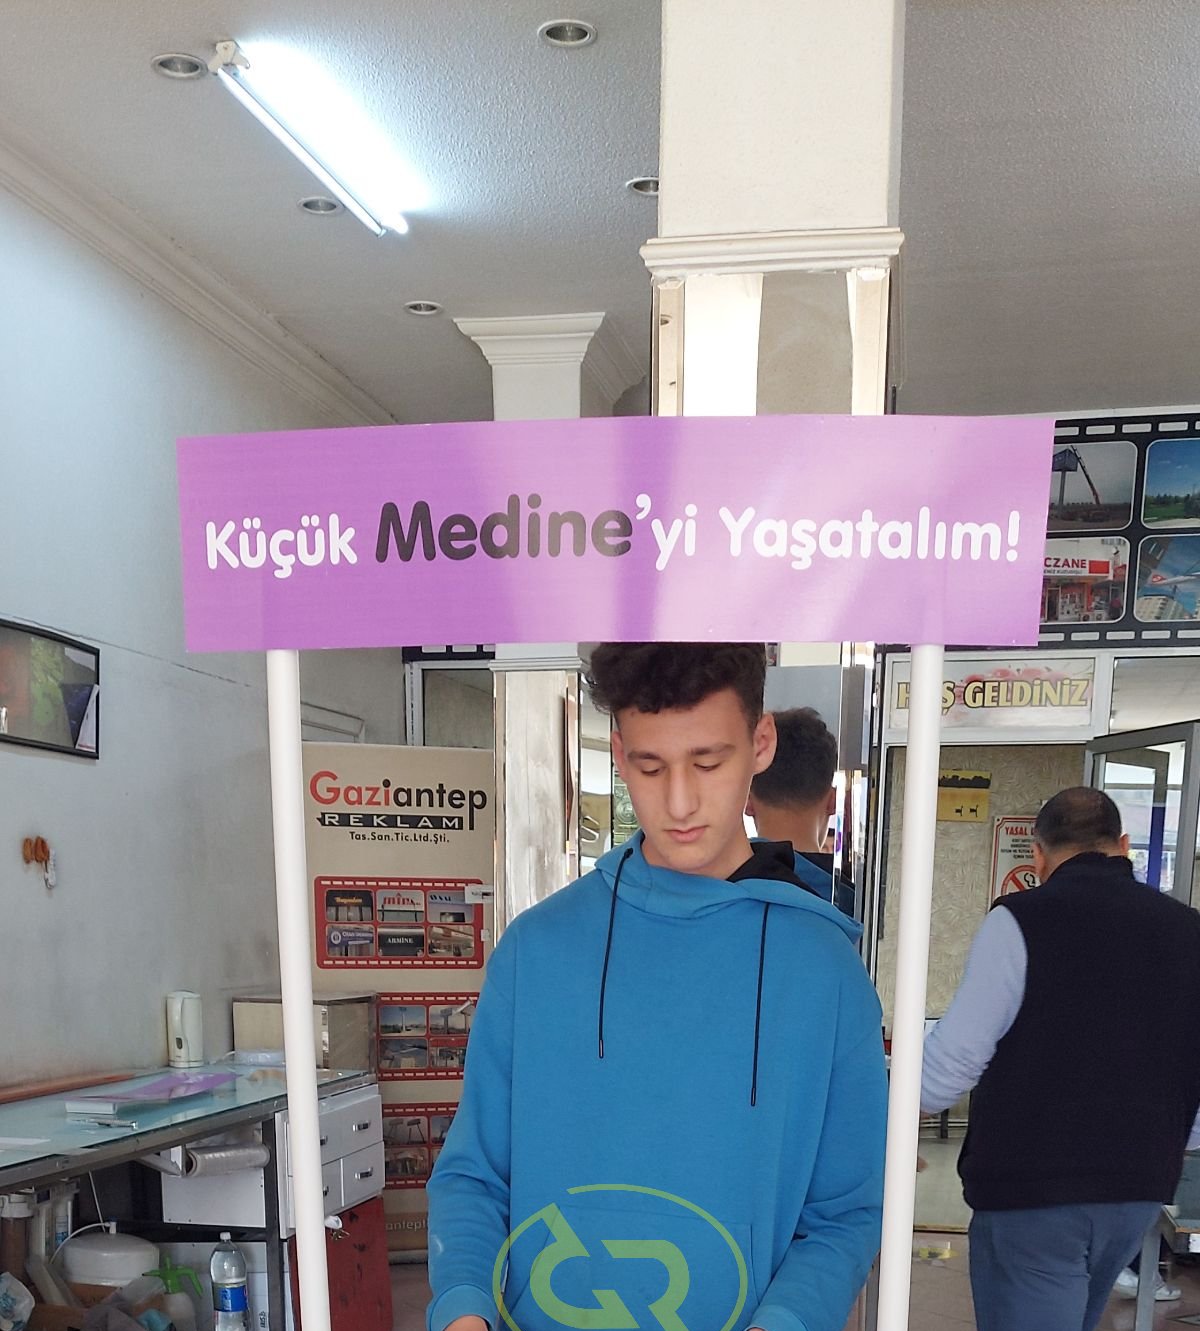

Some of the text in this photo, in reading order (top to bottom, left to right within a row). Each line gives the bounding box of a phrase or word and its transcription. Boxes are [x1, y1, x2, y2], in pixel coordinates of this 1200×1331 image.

[205, 511, 357, 579] Küçük
[719, 506, 1020, 570] Yaşatalım!
[1044, 557, 1087, 569] CZANE
[896, 679, 1089, 716] HŞ GELDİNİZ
[310, 770, 488, 830] Gaziantep
[324, 814, 461, 829] REKLAM
[1005, 826, 1028, 836] YASAL
